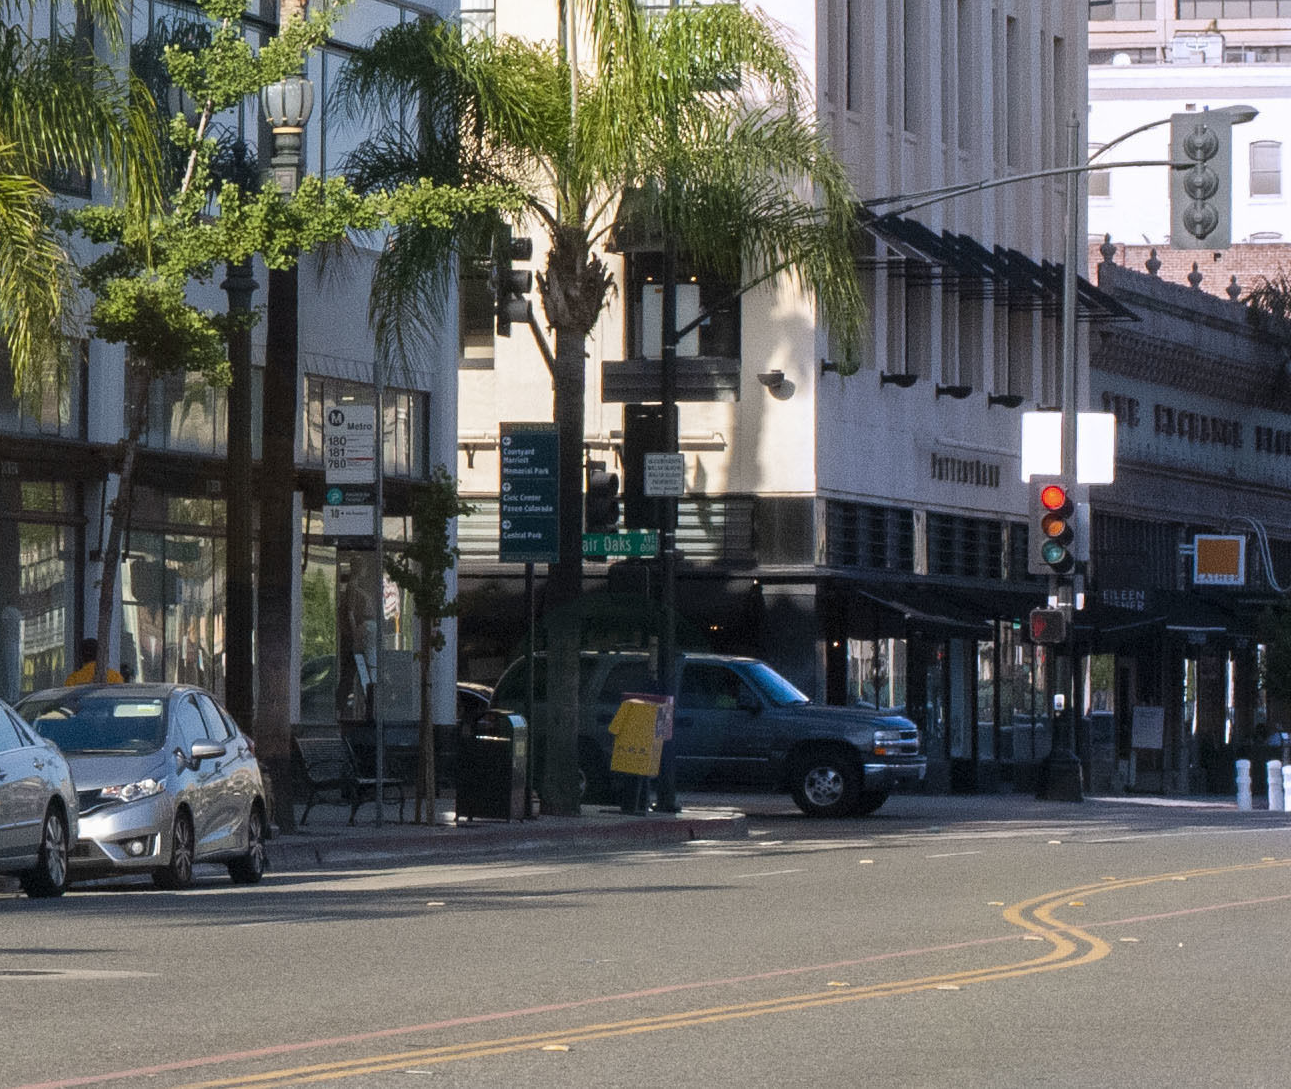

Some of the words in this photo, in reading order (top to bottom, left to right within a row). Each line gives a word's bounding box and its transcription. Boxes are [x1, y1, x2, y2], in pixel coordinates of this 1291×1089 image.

[347, 422, 373, 431] Metro
[328, 436, 347, 446] 180
[328, 447, 346, 457] 181
[503, 448, 535, 456] Courtyard
[582, 537, 598, 552] air
[604, 536, 632, 552] Oaks
[1103, 590, 1145, 600] EILEEN
